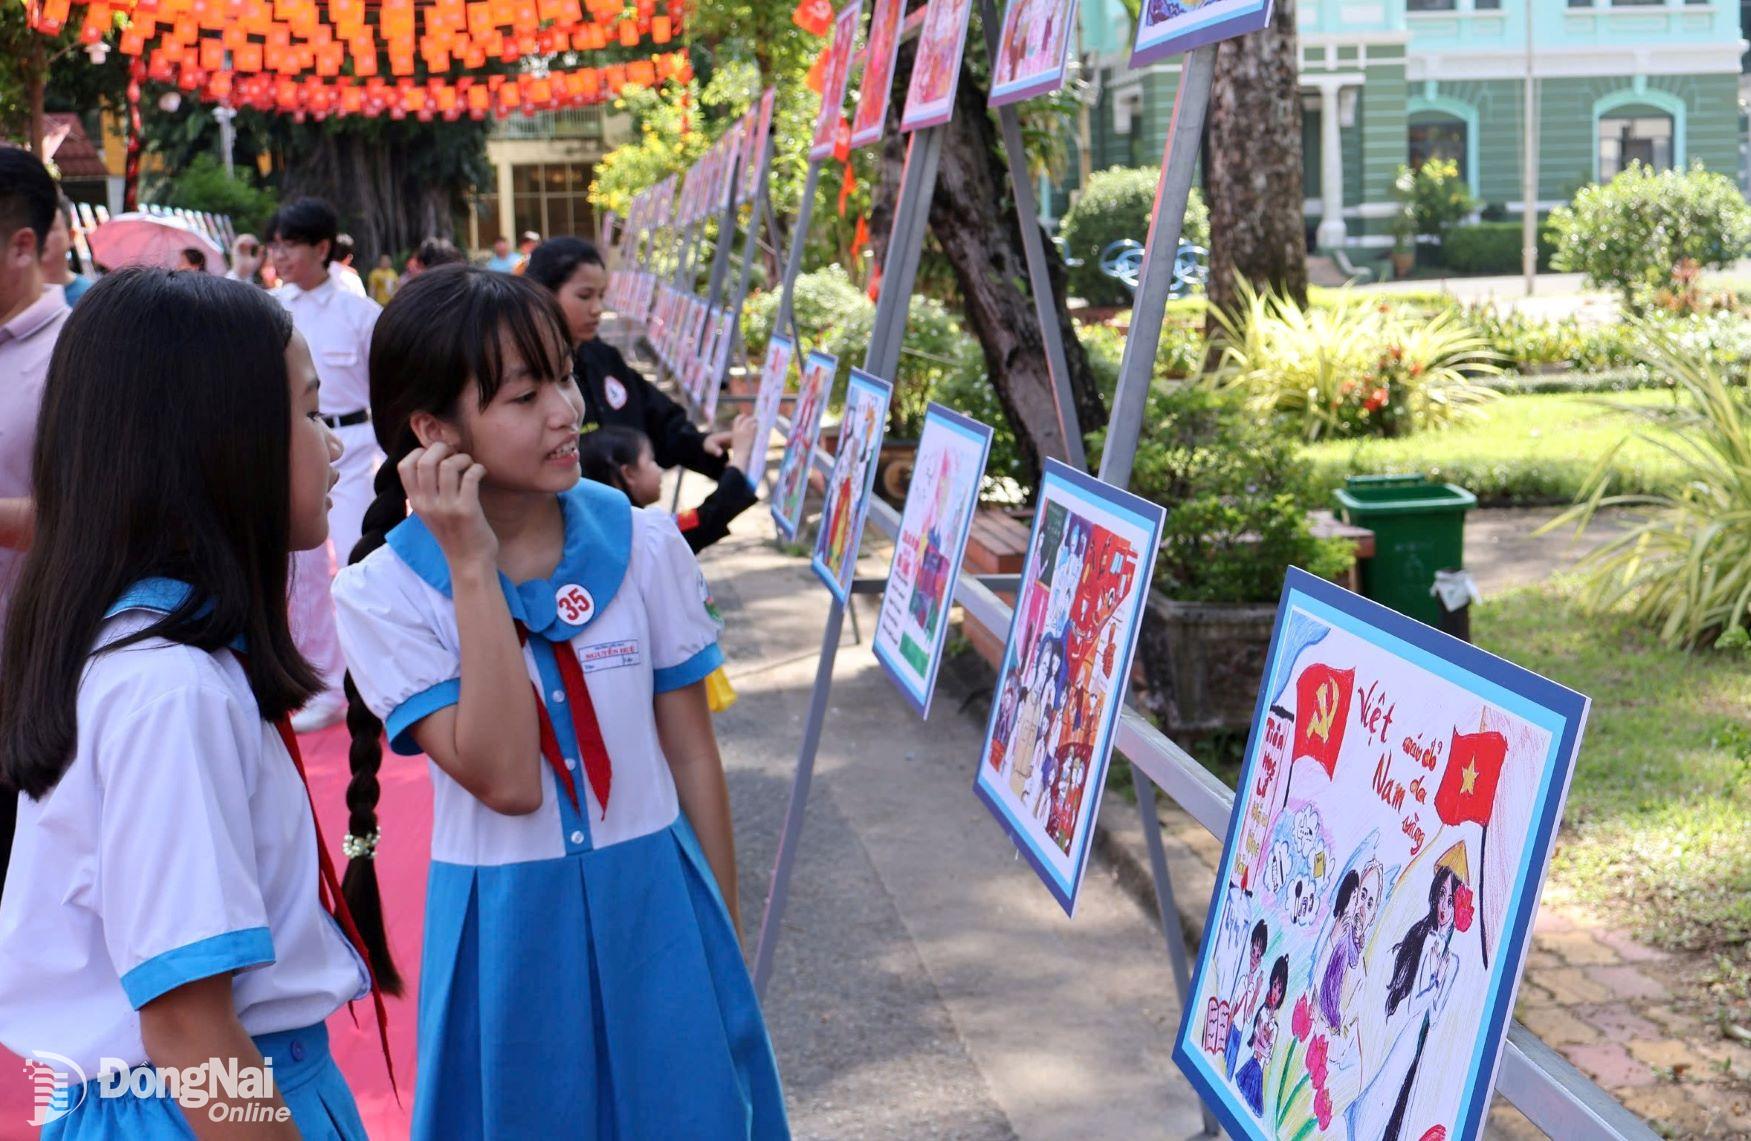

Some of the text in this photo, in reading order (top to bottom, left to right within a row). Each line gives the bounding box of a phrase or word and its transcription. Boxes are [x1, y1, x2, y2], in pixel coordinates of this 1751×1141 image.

[559, 588, 590, 621] 35
[1357, 680, 1396, 747] Việt
[1372, 749, 1406, 814] Nam
